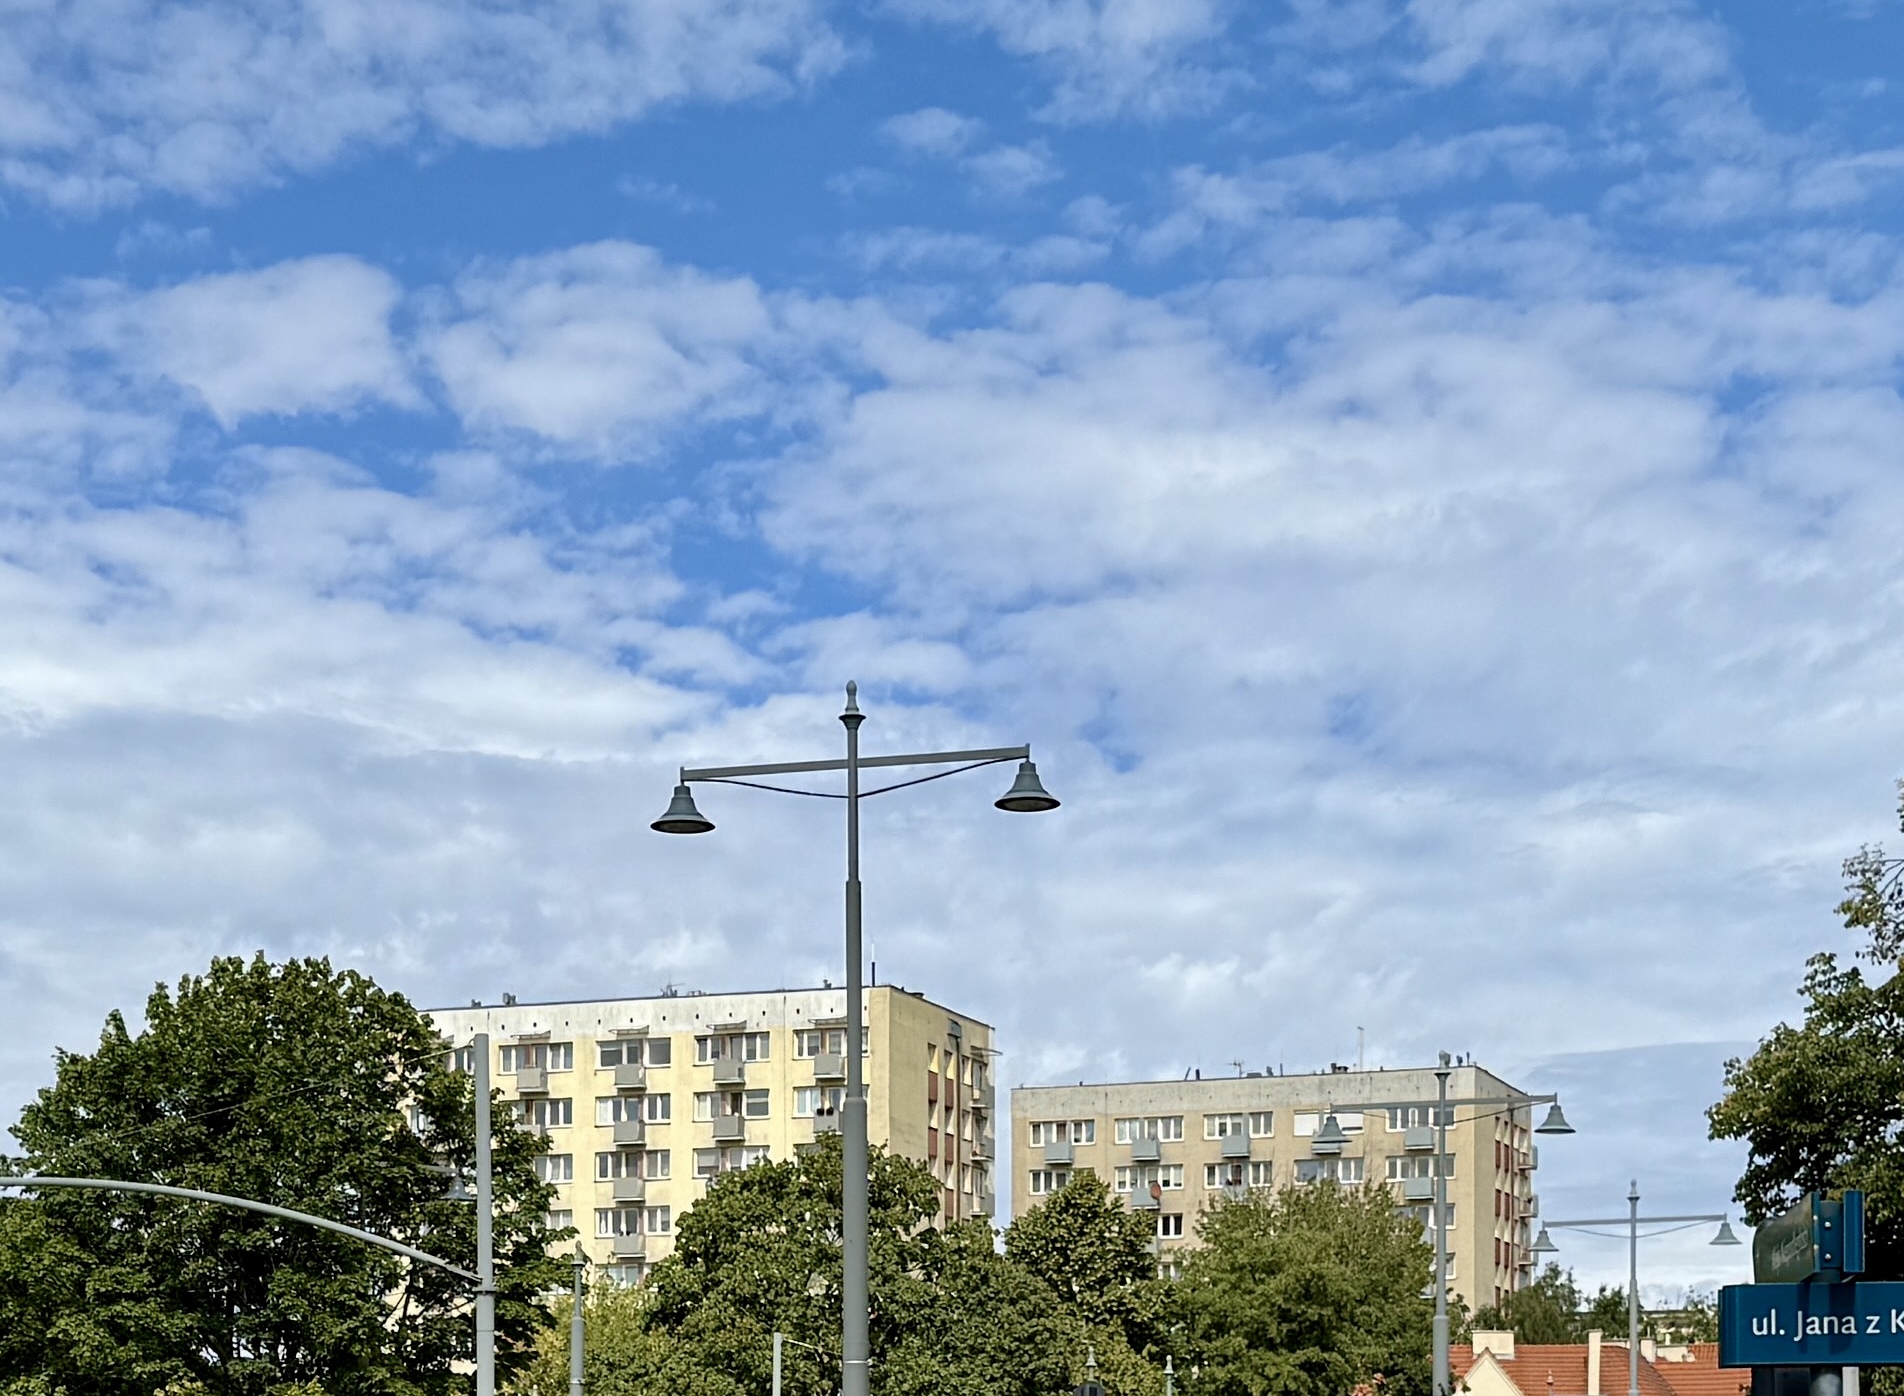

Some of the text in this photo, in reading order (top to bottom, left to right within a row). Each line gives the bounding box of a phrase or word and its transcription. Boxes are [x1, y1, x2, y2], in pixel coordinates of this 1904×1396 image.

[1752, 1308, 1786, 1336] ul.
[1793, 1310, 1858, 1342] Jana
[1865, 1315, 1881, 1334] z
